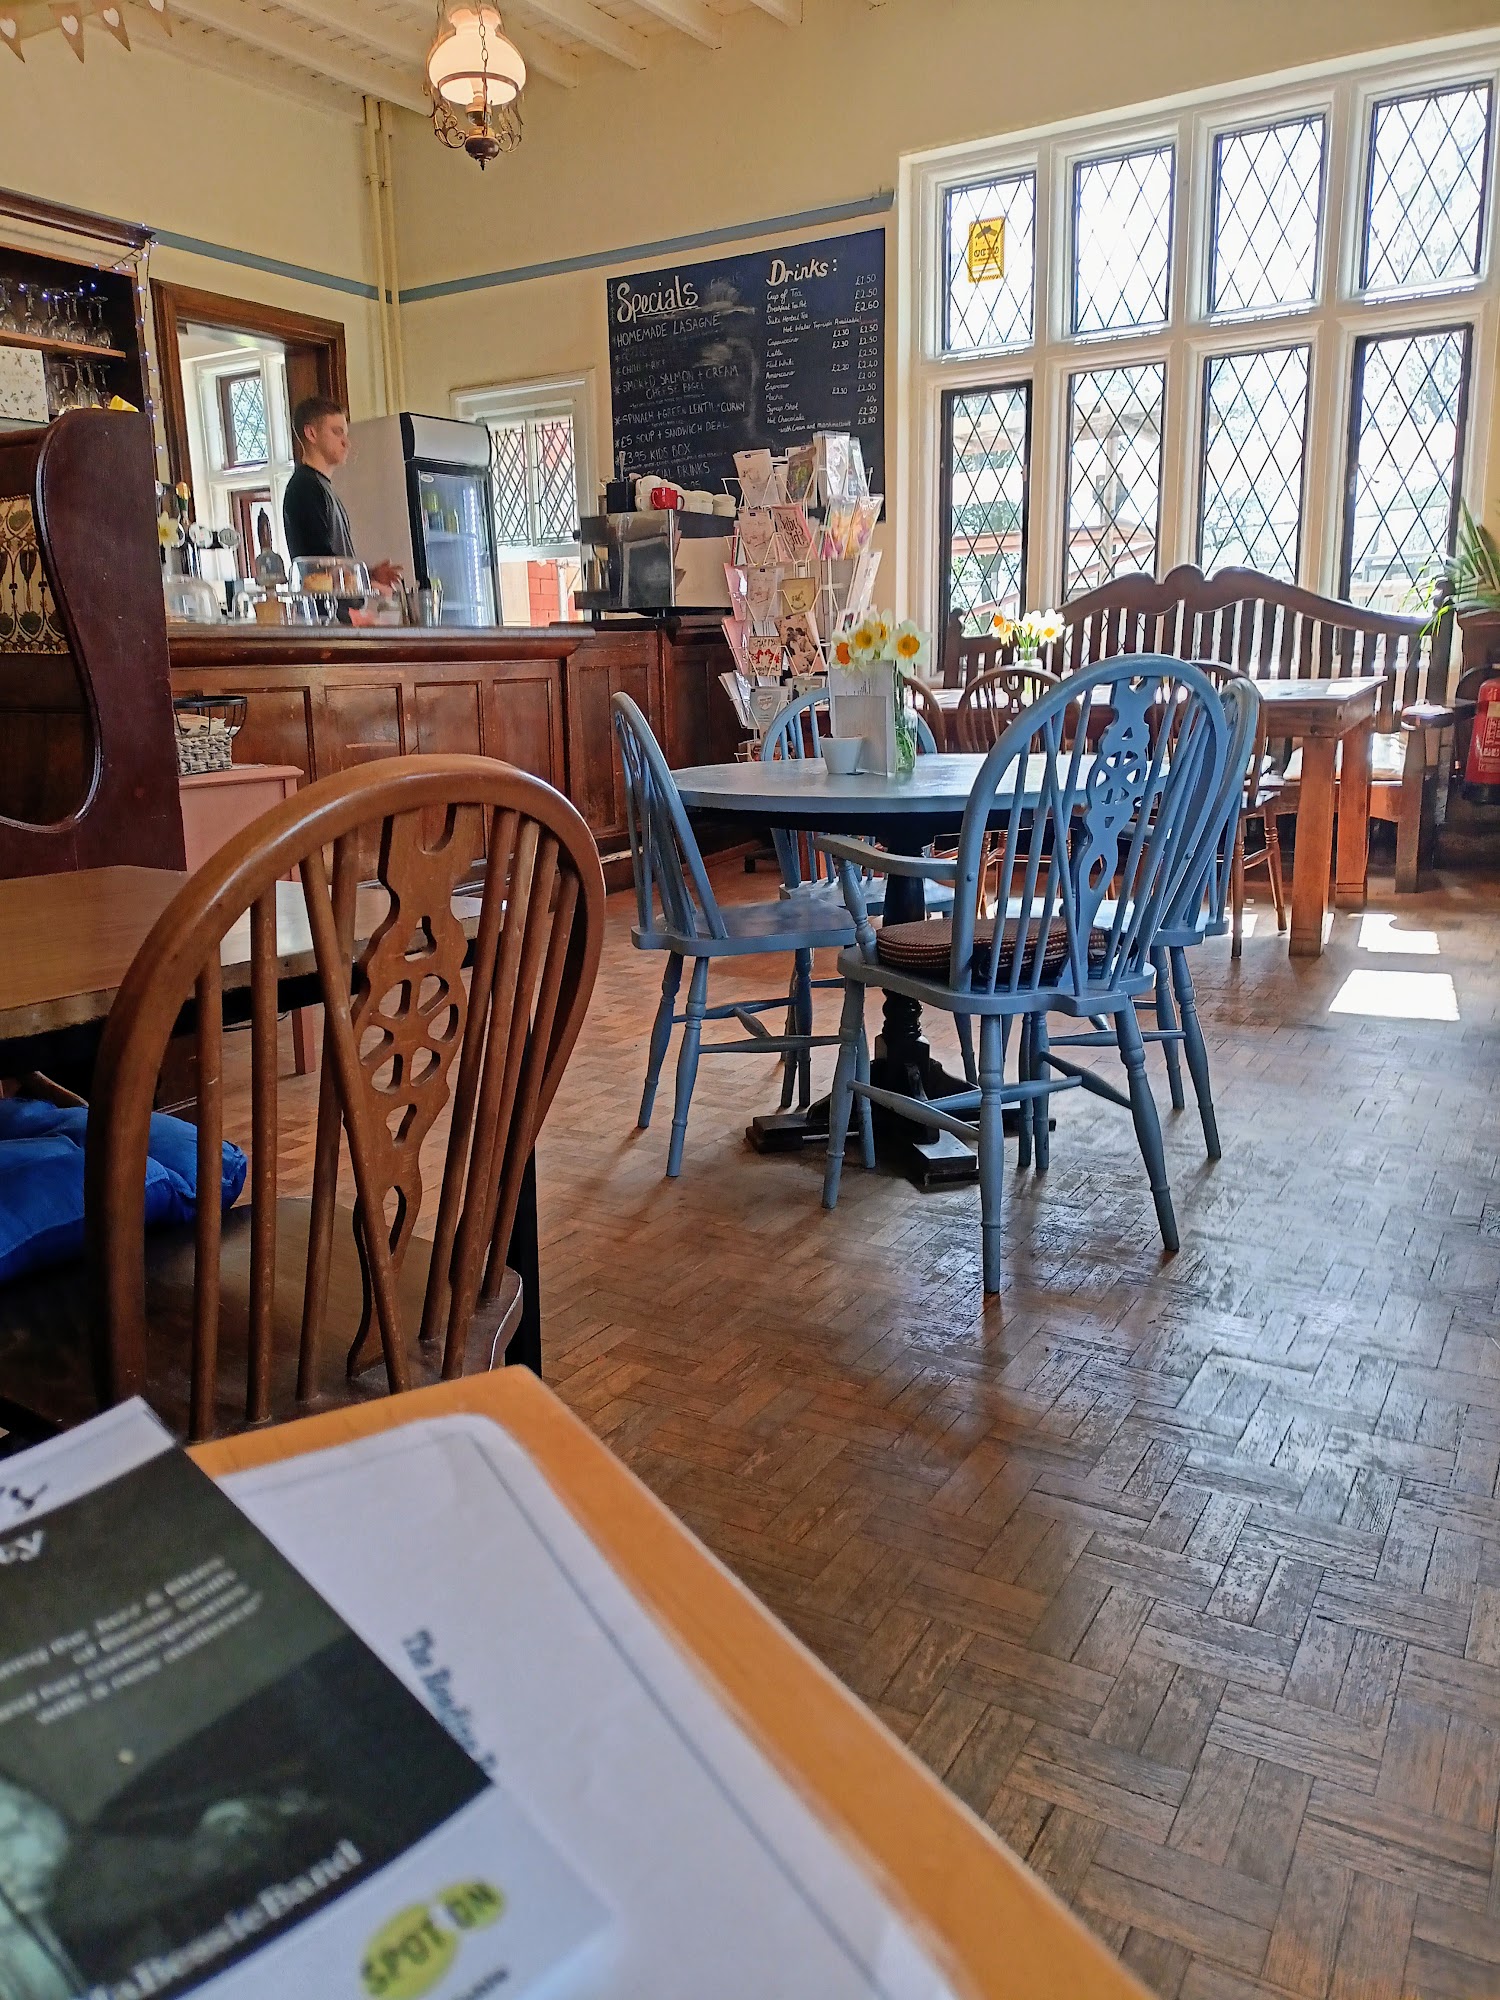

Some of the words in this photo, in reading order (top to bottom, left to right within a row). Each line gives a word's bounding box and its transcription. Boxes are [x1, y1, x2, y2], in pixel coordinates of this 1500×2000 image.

[617, 275, 699, 323] Specials
[767, 291, 779, 303] Cup
[780, 289, 788, 304] of
[790, 288, 803, 297] Tea
[766, 303, 790, 313] Breakfast
[617, 323, 668, 348] HOMEMADE
[673, 312, 720, 335] LASAGNE
[795, 323, 811, 331] Water
[766, 348, 783, 357] Latte
[779, 358, 794, 367] White
[622, 375, 656, 393] SMOKED
[660, 370, 694, 385] SALMON
[705, 365, 739, 379] CREAM
[765, 370, 795, 379] Americano
[645, 384, 679, 400] CHEESE
[682, 382, 704, 393] BAGEL
[622, 410, 654, 425] SPINACH
[662, 406, 687, 419] GREEN
[720, 401, 746, 413] CURRY
[778, 413, 805, 423] Chocolate
[621, 434, 633, 449] £5
[636, 430, 655, 444] SOUP
[664, 423, 703, 439] SANDWICH
[705, 421, 729, 432] DEAL
[650, 446, 669, 461] KIDS
[672, 443, 691, 457] BOX
[676, 461, 711, 478] DRINKS
[359, 1915, 448, 1997] SPOT
